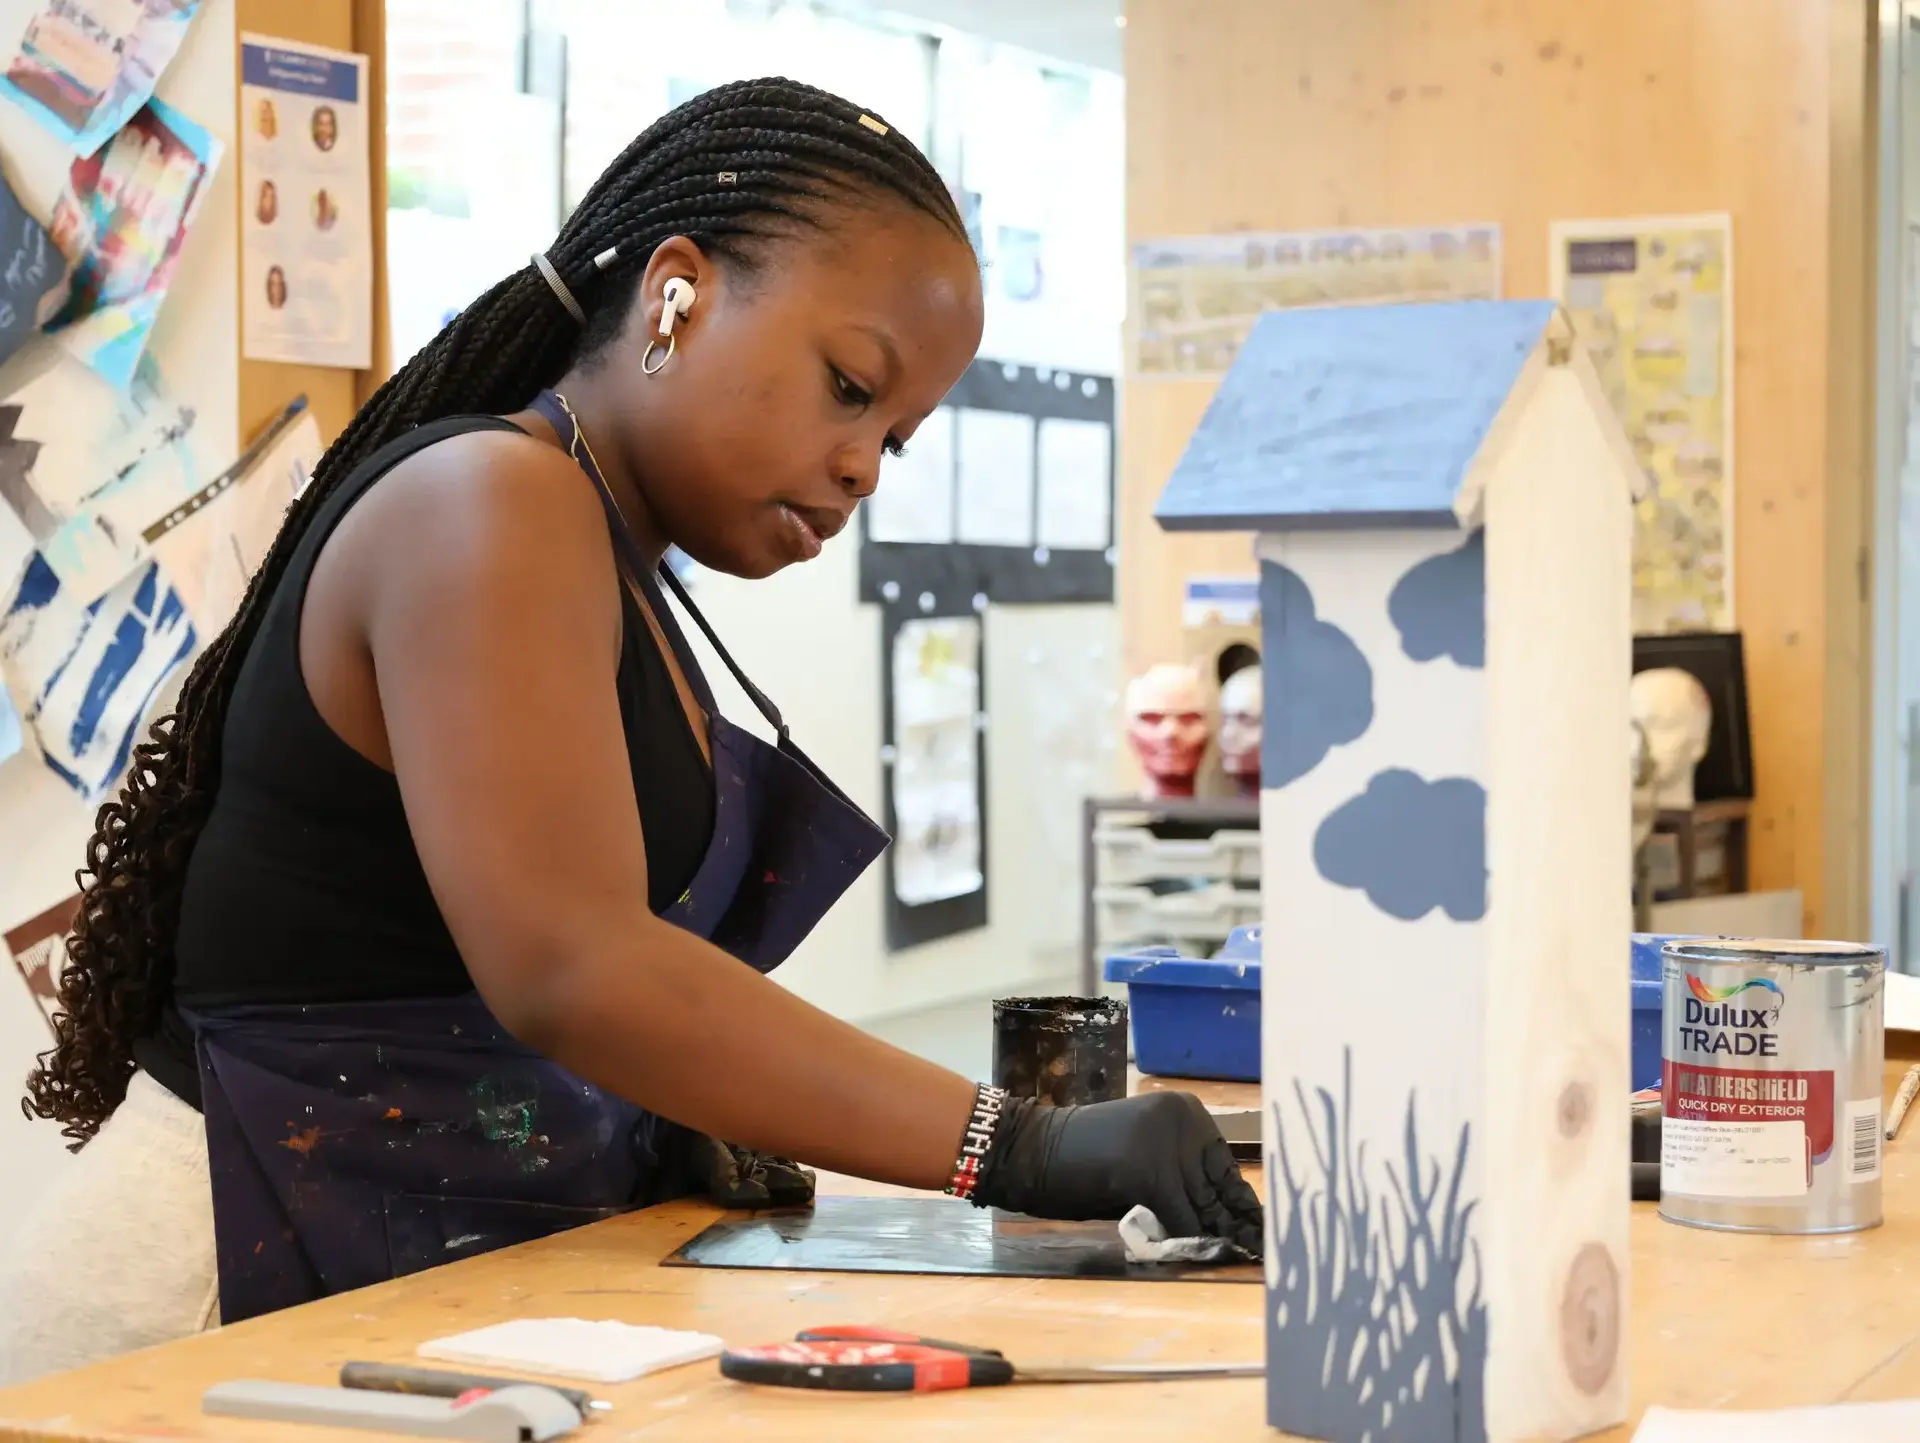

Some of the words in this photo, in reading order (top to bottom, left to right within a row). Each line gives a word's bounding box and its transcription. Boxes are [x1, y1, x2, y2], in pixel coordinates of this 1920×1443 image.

[1685, 997, 1768, 1028] Dulux
[1679, 1026, 1778, 1057] TRADE
[1679, 1098, 1708, 1112] QUICK
[1710, 1102, 1737, 1114] DRY
[1739, 1104, 1805, 1116] EXTERIOR
